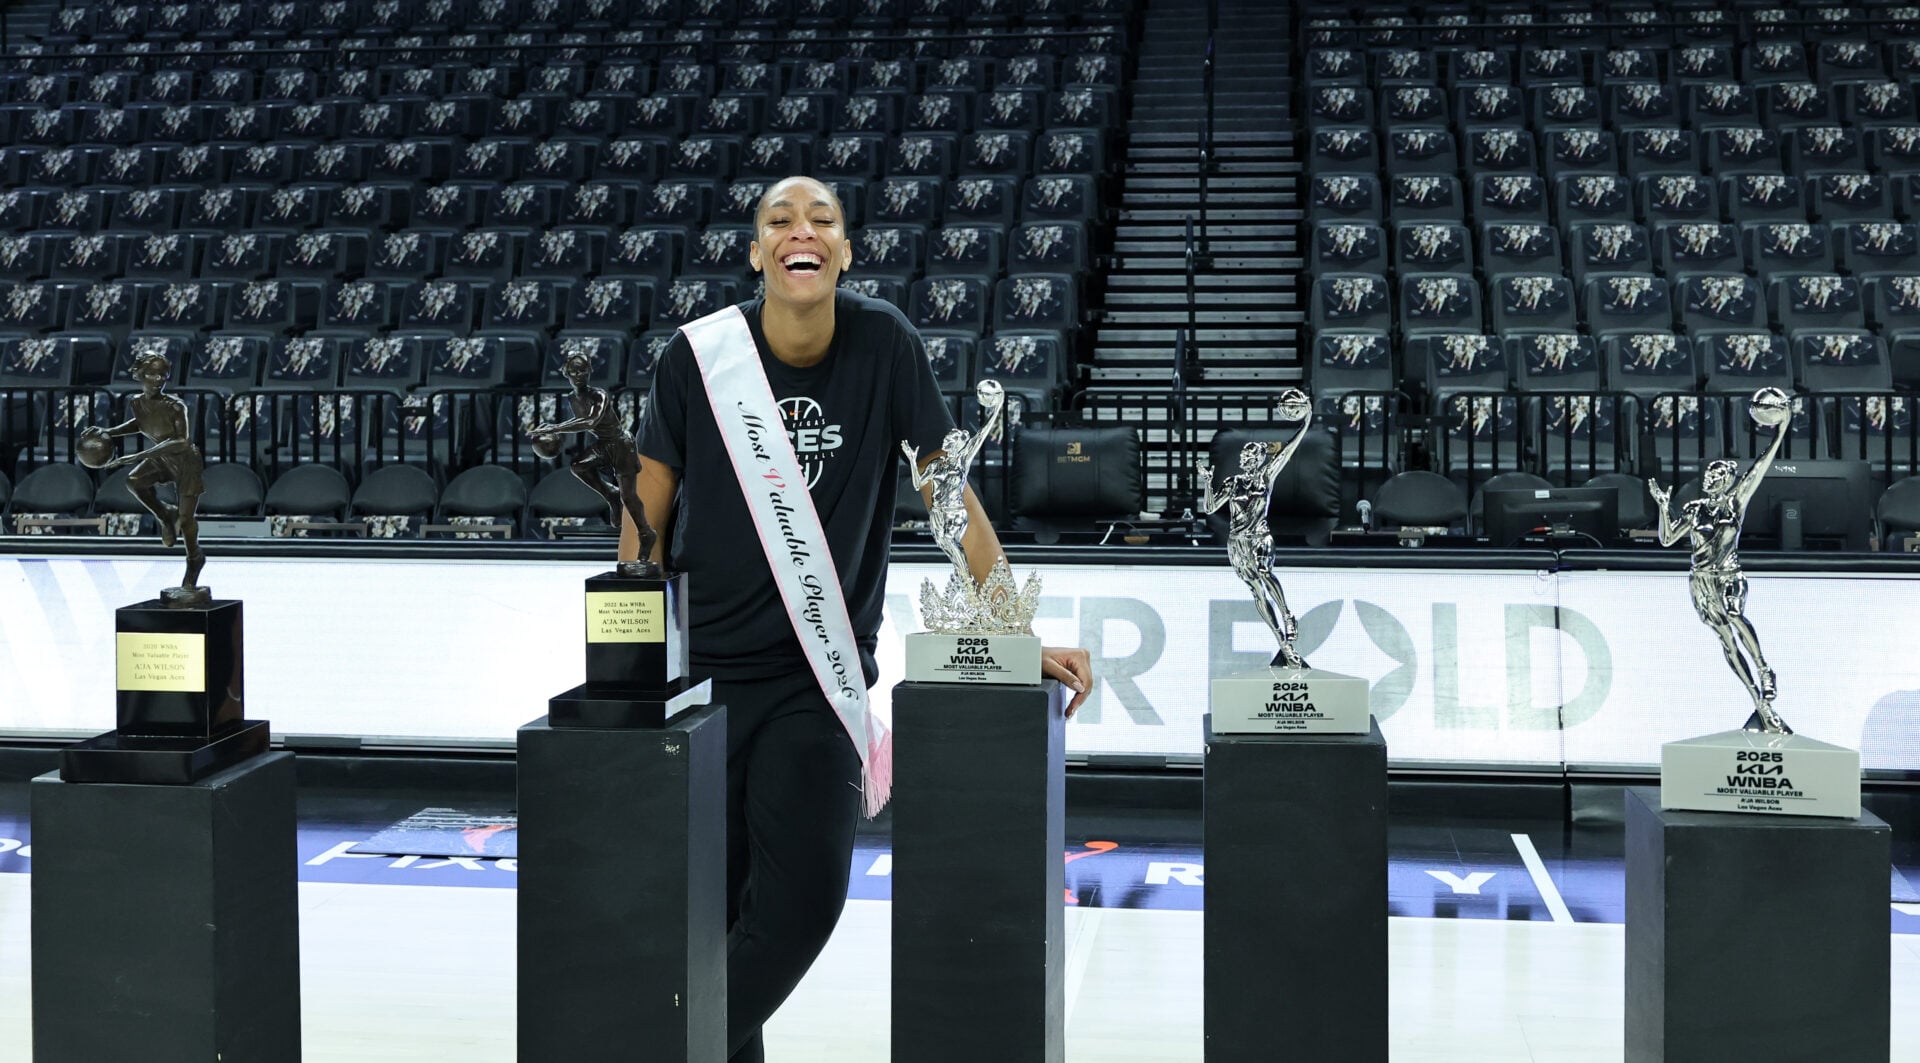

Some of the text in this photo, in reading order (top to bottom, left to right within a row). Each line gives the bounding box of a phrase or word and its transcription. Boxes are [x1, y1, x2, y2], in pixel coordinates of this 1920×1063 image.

[1057, 455, 1091, 465] BETMGM
[737, 401, 859, 702] Most Valuable Player 2026
[957, 638, 989, 646] 2026
[950, 655, 996, 665] WNBA
[153, 663, 185, 671] WILSON
[148, 673, 167, 681] Vegas
[1272, 682, 1308, 691] 2024
[1265, 703, 1316, 712] WNBA
[1736, 751, 1783, 763] 2025
[1726, 775, 1793, 790] WNBA
[1739, 788, 1775, 796] VALUABLE
